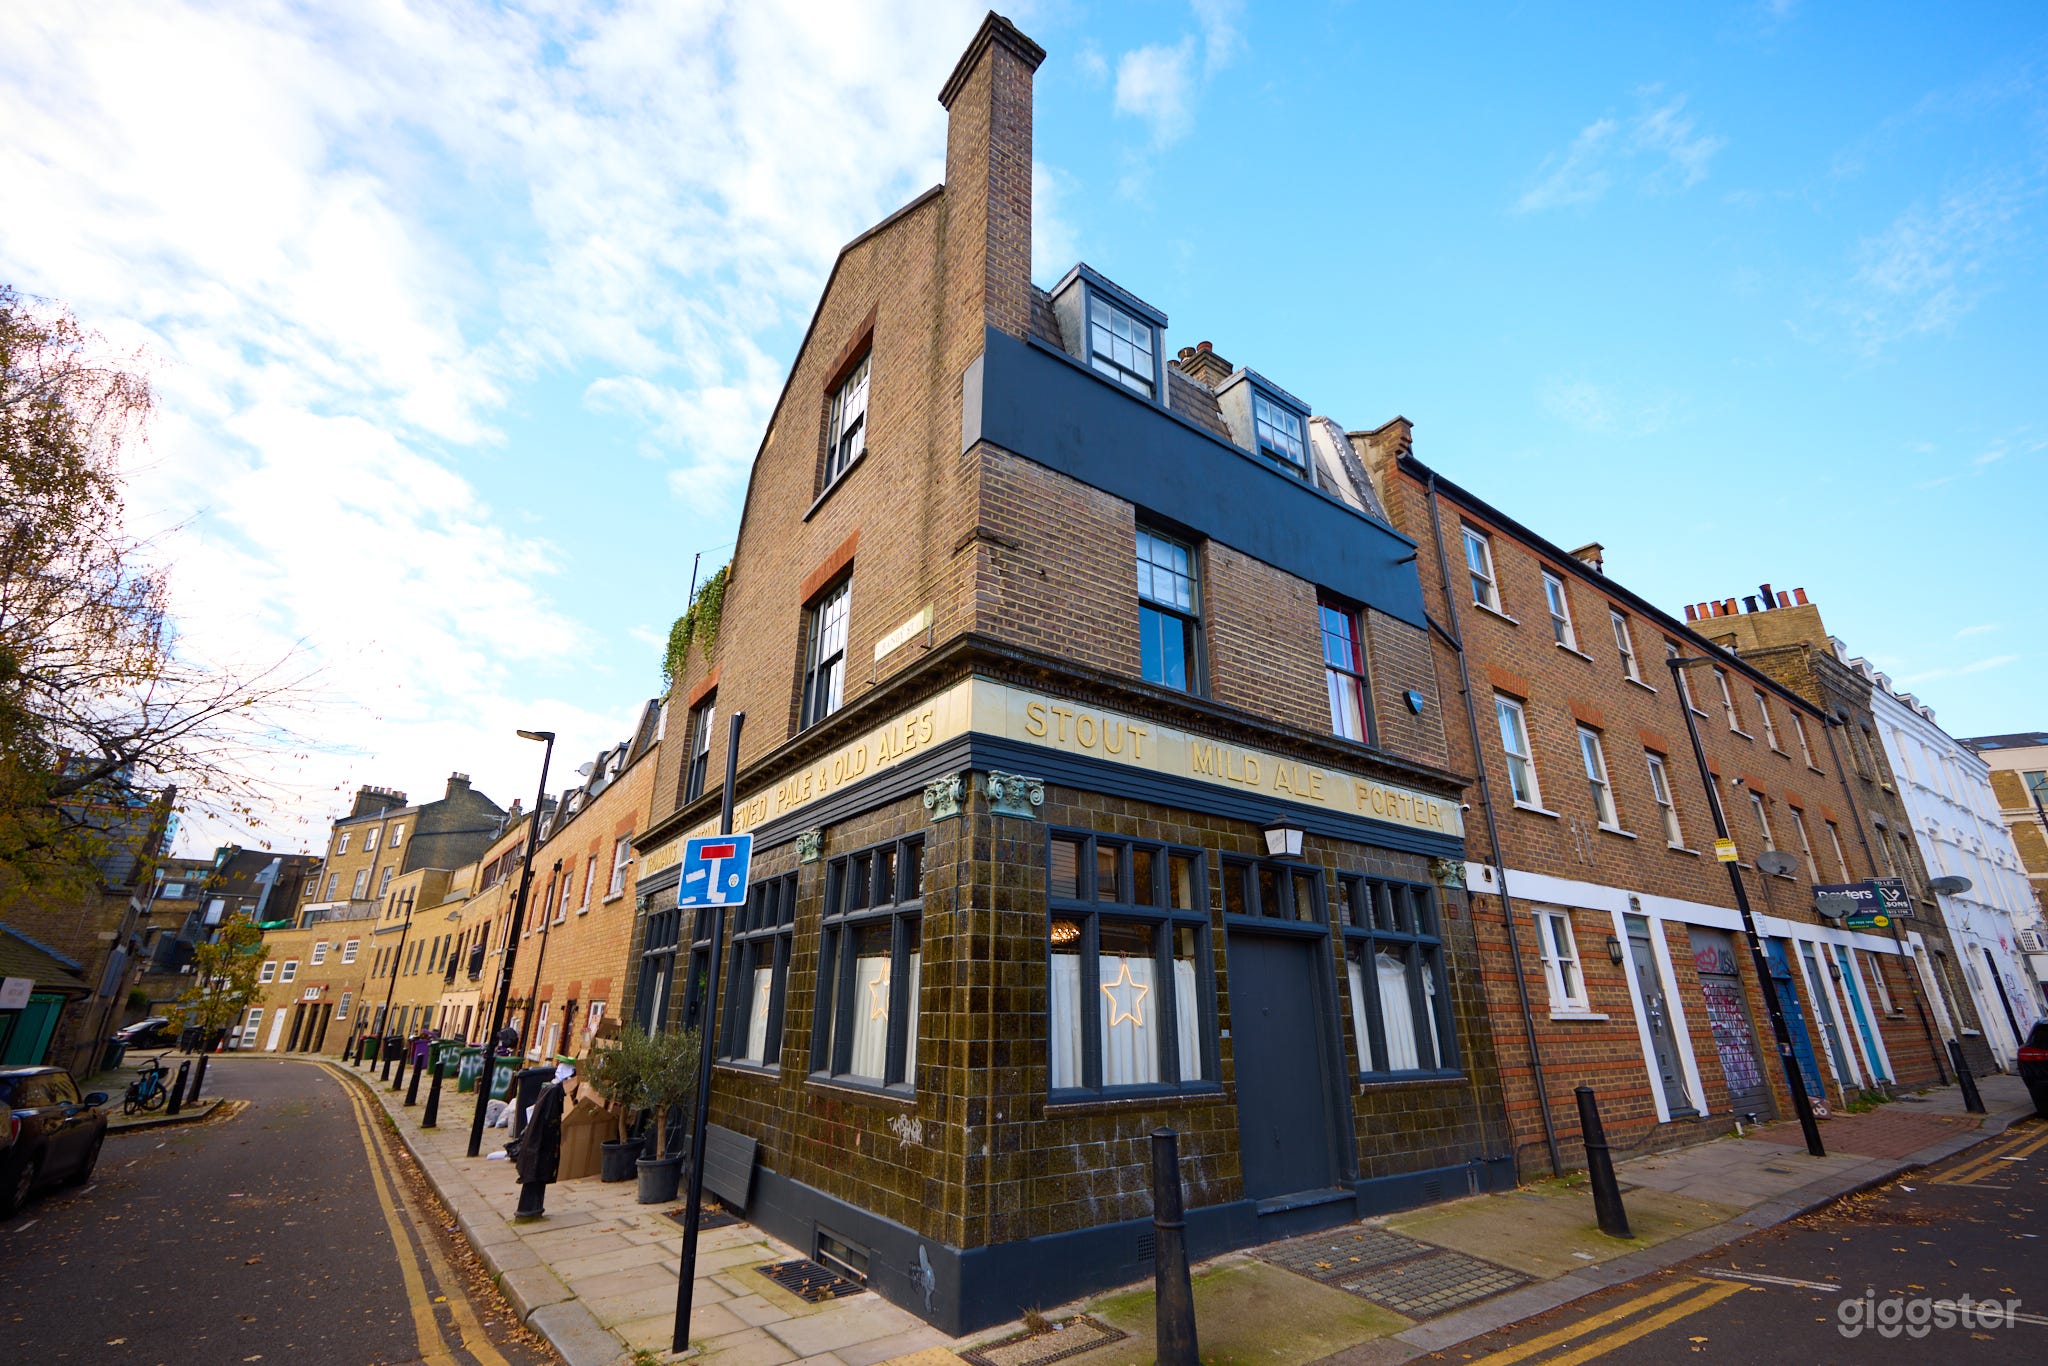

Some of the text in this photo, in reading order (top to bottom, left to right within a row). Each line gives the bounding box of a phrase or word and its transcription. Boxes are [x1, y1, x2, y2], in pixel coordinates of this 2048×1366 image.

[732, 796, 768, 832] EWED
[777, 772, 812, 813] PALE
[818, 767, 827, 791] &
[833, 744, 867, 785] OLD
[876, 710, 933, 766] ALES
[1025, 701, 1442, 827] STOUT MILD ALE PORTER
